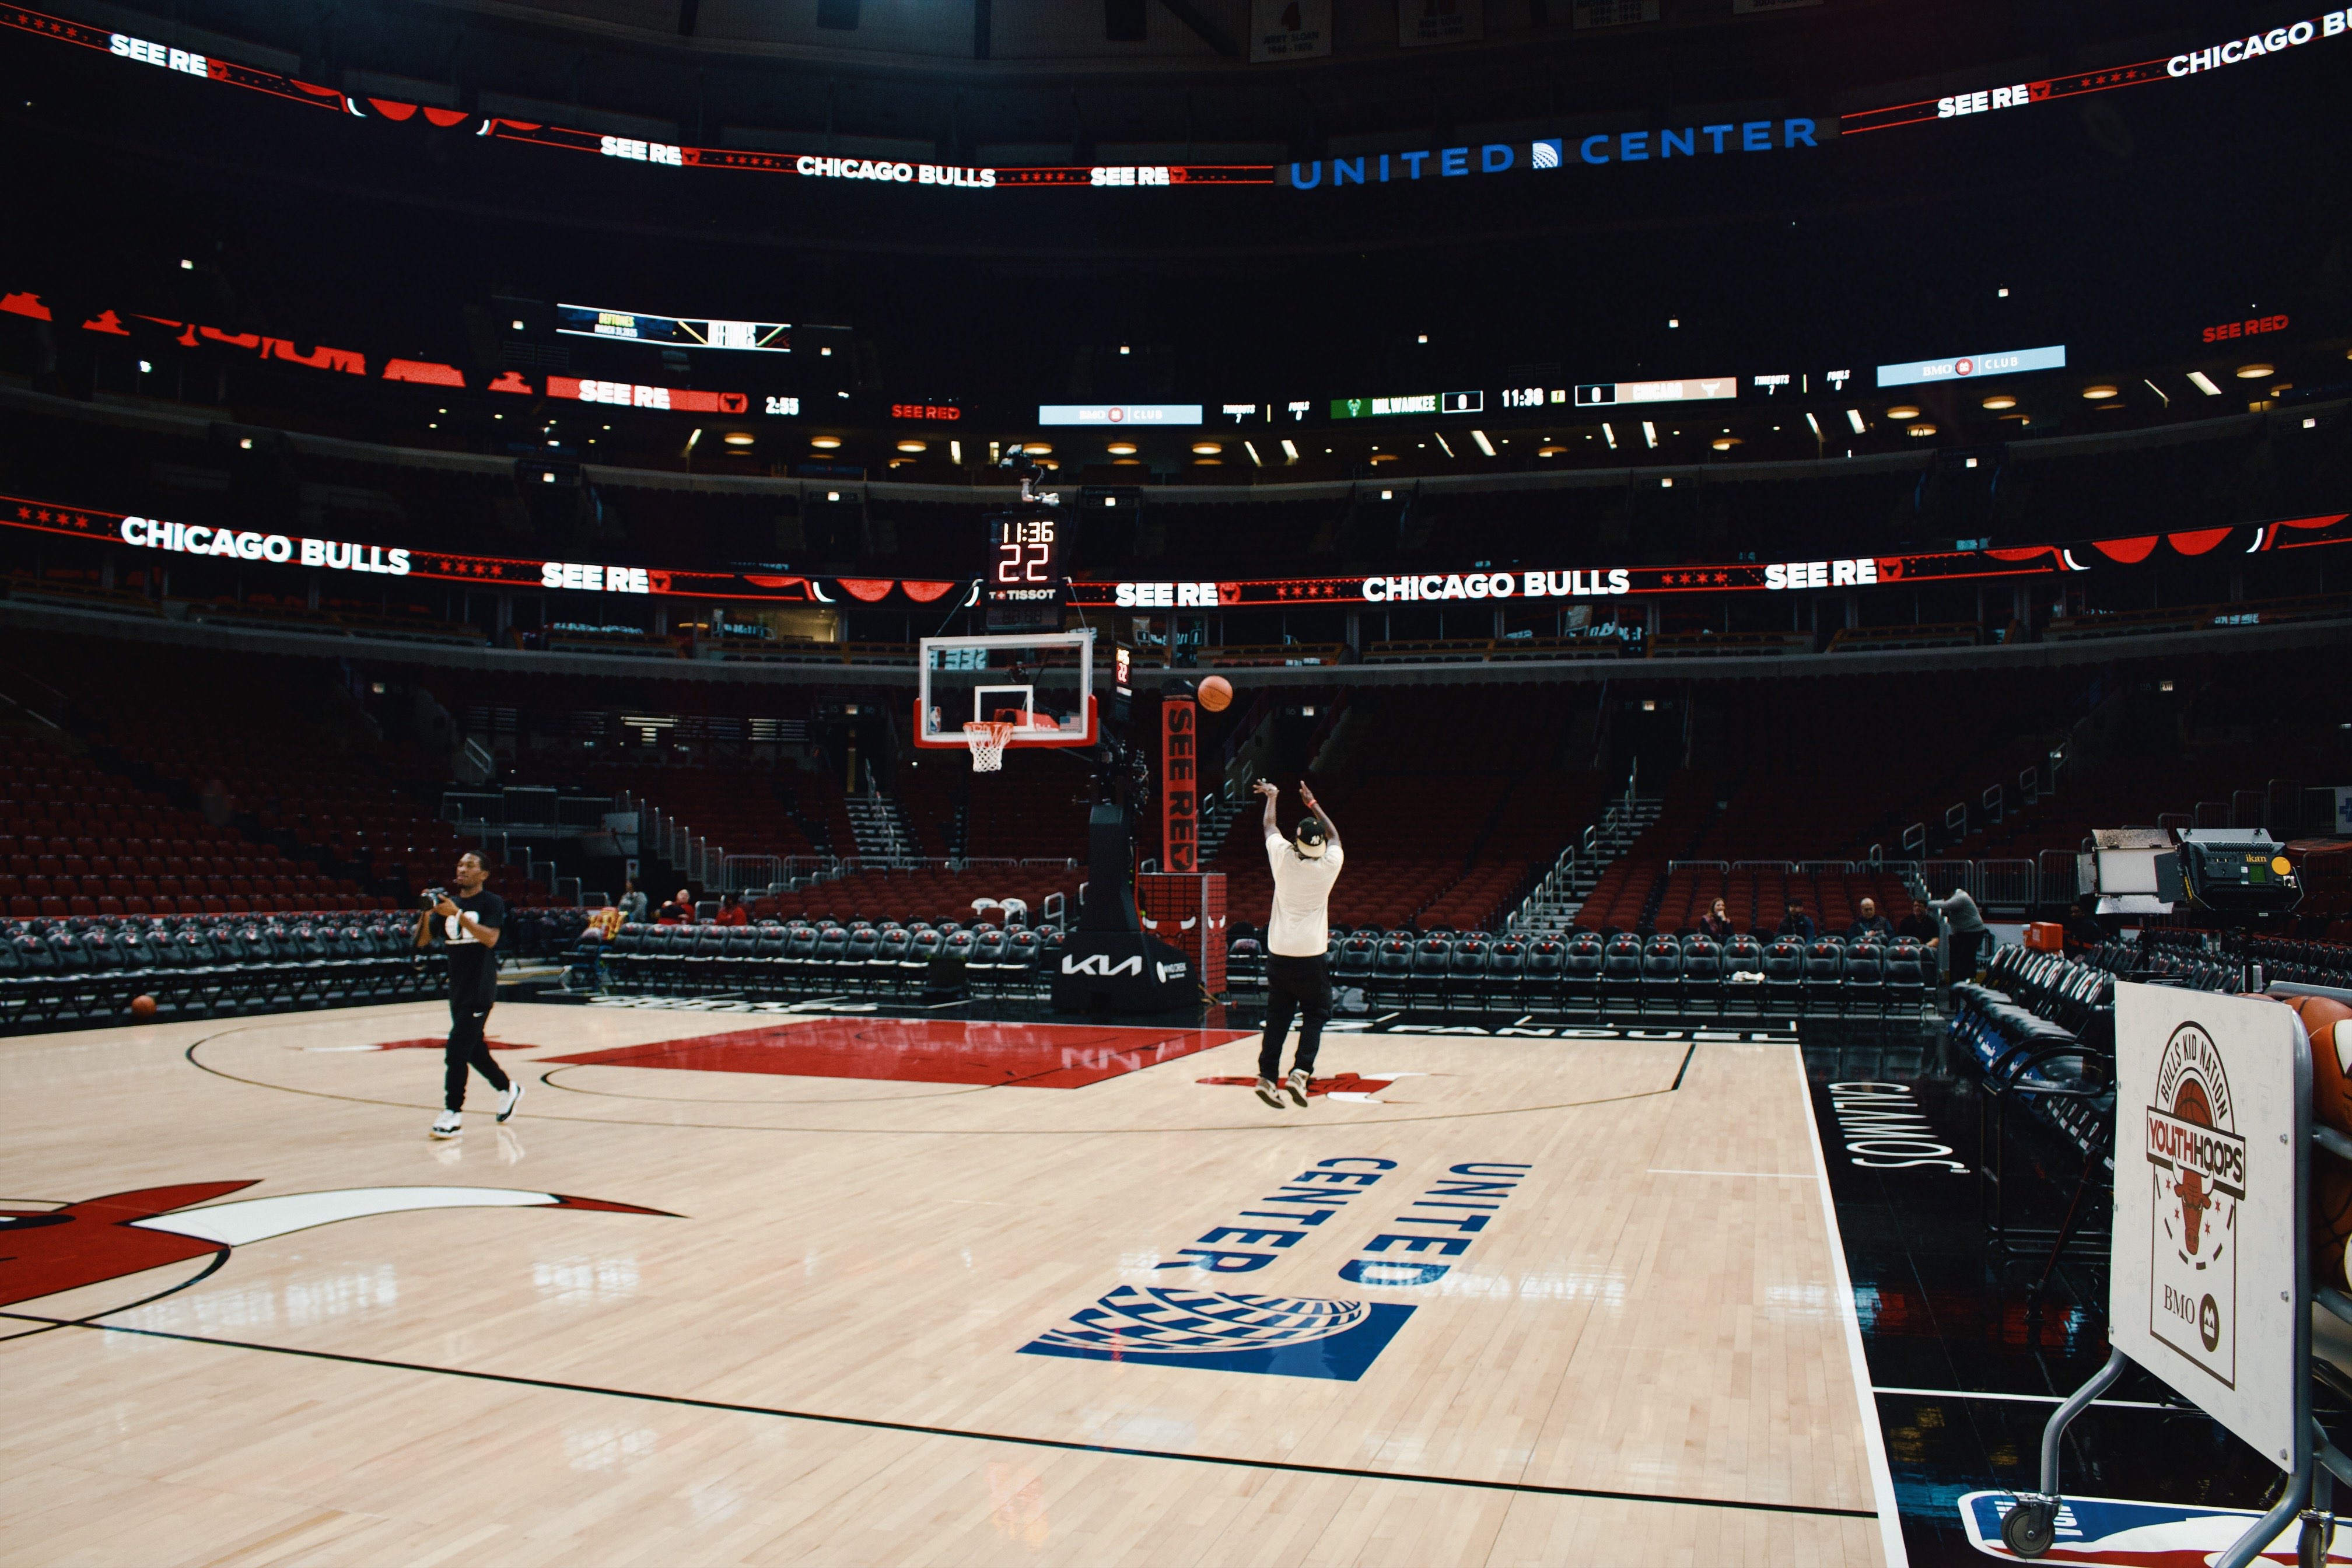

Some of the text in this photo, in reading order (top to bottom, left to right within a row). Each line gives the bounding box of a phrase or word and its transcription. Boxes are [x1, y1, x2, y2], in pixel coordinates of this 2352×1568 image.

[109, 33, 167, 67] SEE
[2166, 21, 2314, 77] CHICAGO
[1937, 90, 1989, 118] SEE
[600, 135, 648, 160] SEE
[1291, 118, 1818, 189] UNITED CENTER
[796, 156, 996, 187] CHICAGO BULLS
[1090, 166, 1136, 186] SEE
[2203, 323, 2241, 343] SEE
[1826, 369, 1850, 381] FOULS
[1923, 356, 2018, 376] BMO CLUB
[1754, 374, 1790, 386] TIMEOUTS
[1769, 385, 1775, 395] 7
[578, 379, 632, 405] SEE
[1458, 394, 1468, 410] 0
[1502, 387, 1544, 407] 11:36
[1591, 387, 1601, 403] 0
[1633, 382, 1684, 401] CHICAGO
[765, 396, 799, 415] 2:55
[892, 404, 923, 419] SEE
[1079, 410, 1163, 419] BMO CLUB
[1223, 404, 1256, 414] TIMEOUTS
[1288, 401, 1310, 412] FOULS
[1372, 395, 1436, 414] MILWAUKEE
[1003, 522, 1054, 543] 11:36
[121, 516, 411, 575] CHICAGO BULLS
[999, 543, 1049, 582] 22
[541, 562, 604, 590] SEE
[1362, 569, 1630, 602] CHICAGO BULLS
[1765, 561, 1828, 590] SEE
[1006, 589, 1056, 600] TISSOT
[1115, 583, 1174, 607] SEE
[1168, 708, 1194, 780] SEE
[2246, 854, 2267, 862] ikan
[1062, 954, 1142, 977] KIA
[1387, 1024, 1799, 1042] FANDUEL
[2160, 1033, 2228, 1121] BULLS KID NATION
[1153, 1157, 1398, 1274] CENTER
[1338, 1162, 1533, 1287] UNITED
[2164, 1283, 2195, 1325] BMO
